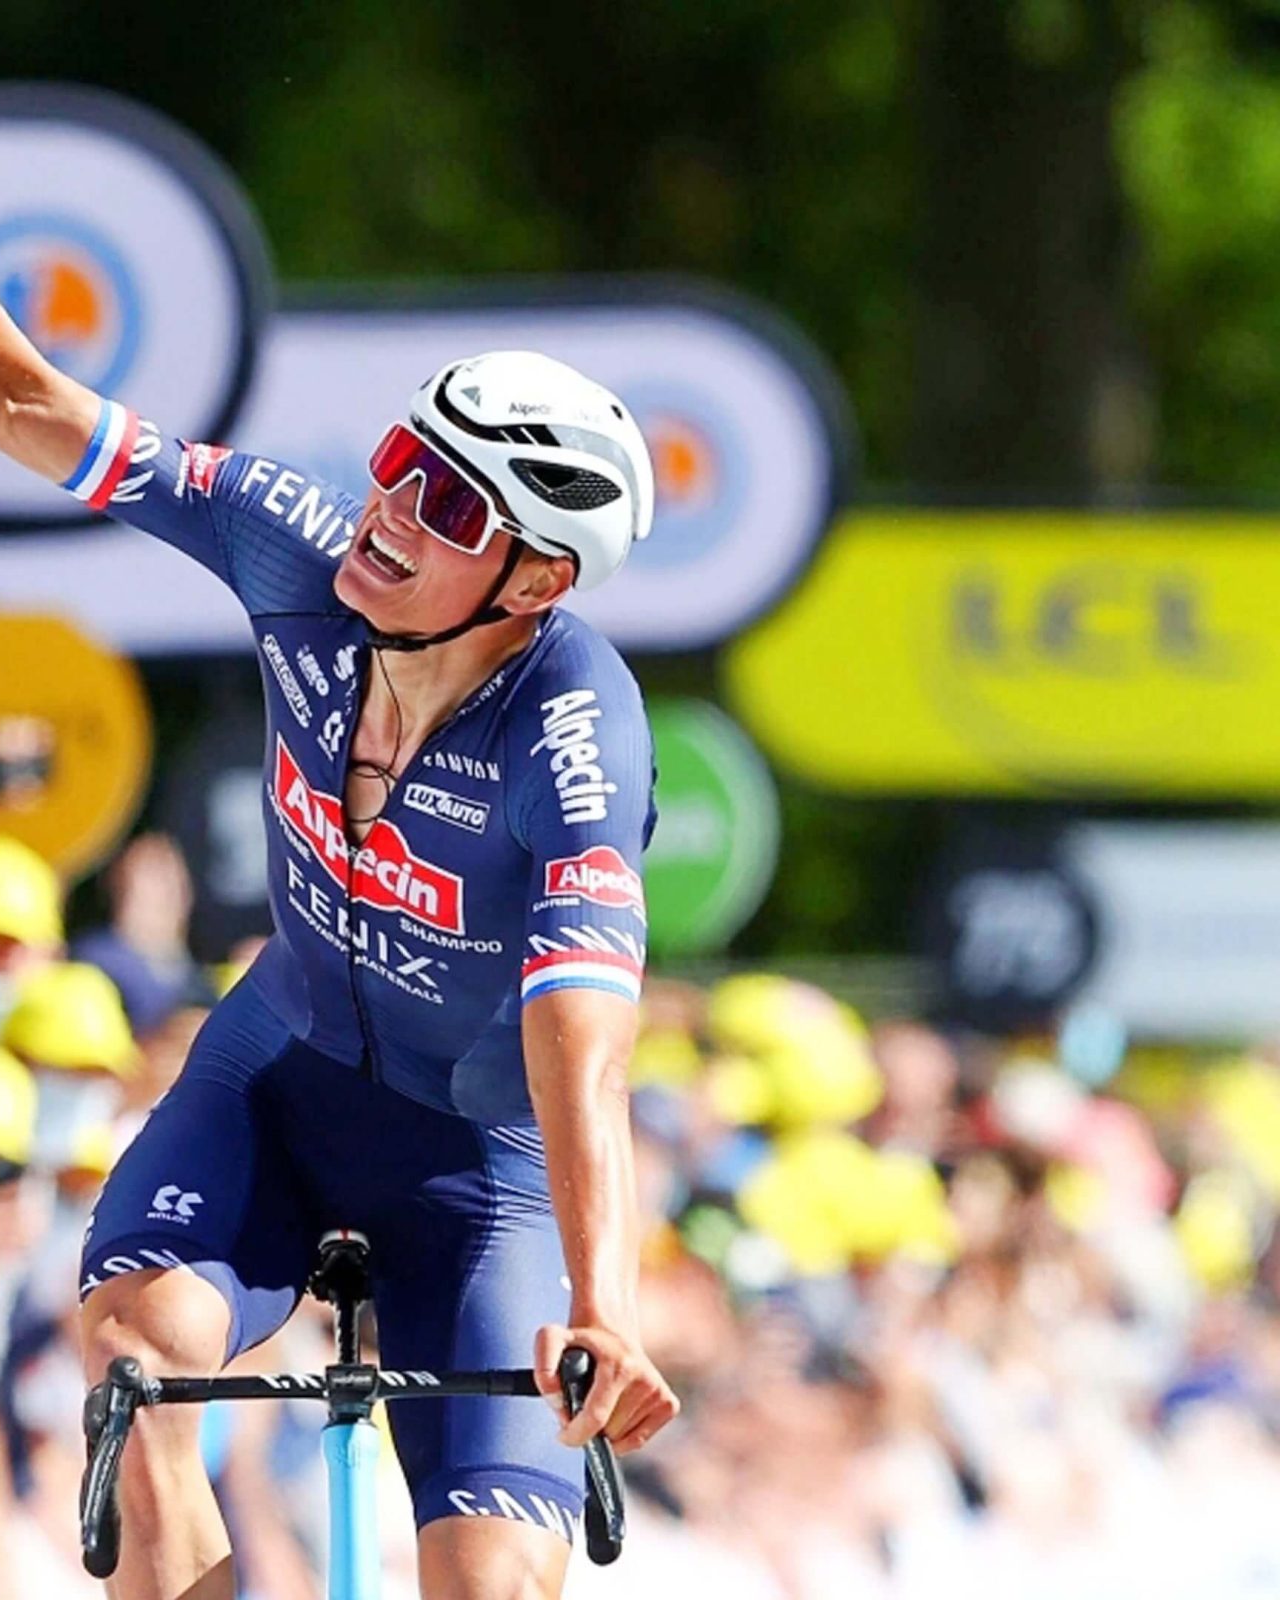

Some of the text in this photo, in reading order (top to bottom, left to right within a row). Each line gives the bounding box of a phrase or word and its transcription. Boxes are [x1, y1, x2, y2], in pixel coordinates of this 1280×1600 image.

[531, 689, 618, 825] Alpecin
[285, 776, 439, 917] Alpecin
[286, 855, 439, 989] FENIX
[353, 954, 445, 1005] MATERIALS
[399, 917, 504, 954] SHAMPOO
